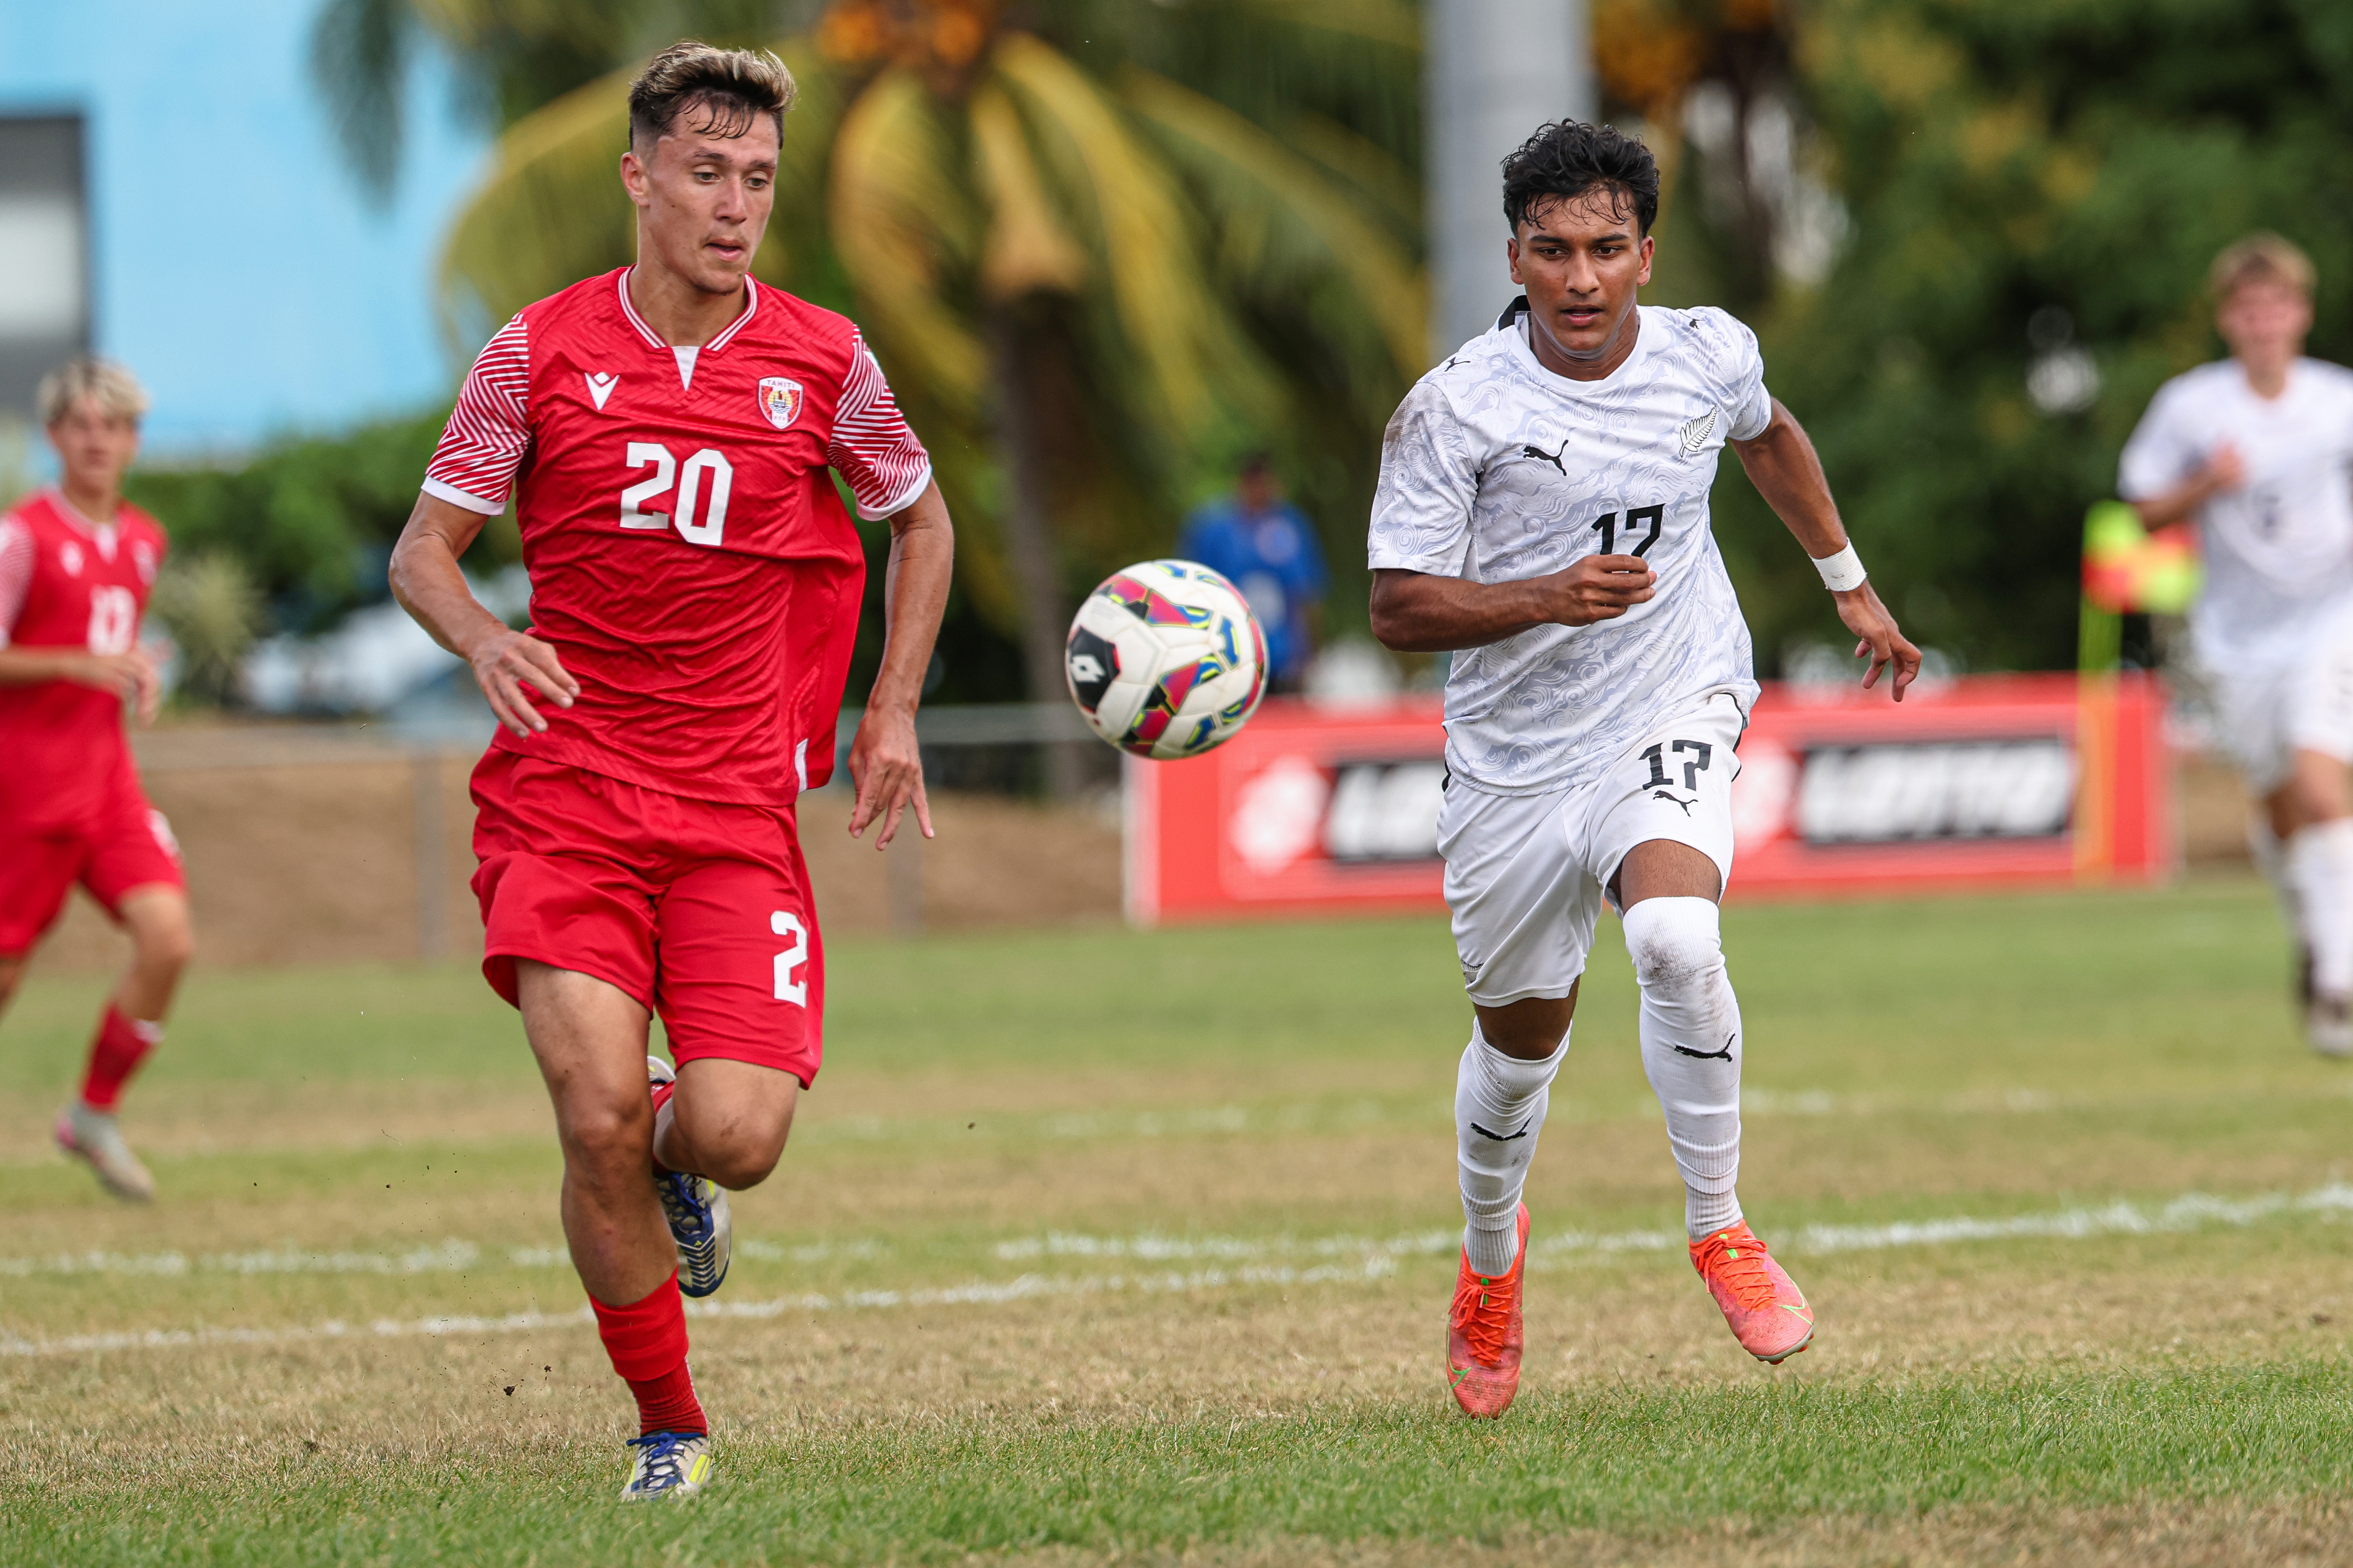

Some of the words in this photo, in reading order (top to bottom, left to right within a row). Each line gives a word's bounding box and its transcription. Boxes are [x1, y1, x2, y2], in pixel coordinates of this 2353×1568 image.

[767, 380, 795, 389] TAHITI
[619, 442, 734, 546] 20
[1591, 502, 1666, 558] 17
[1638, 739, 1714, 791] 17
